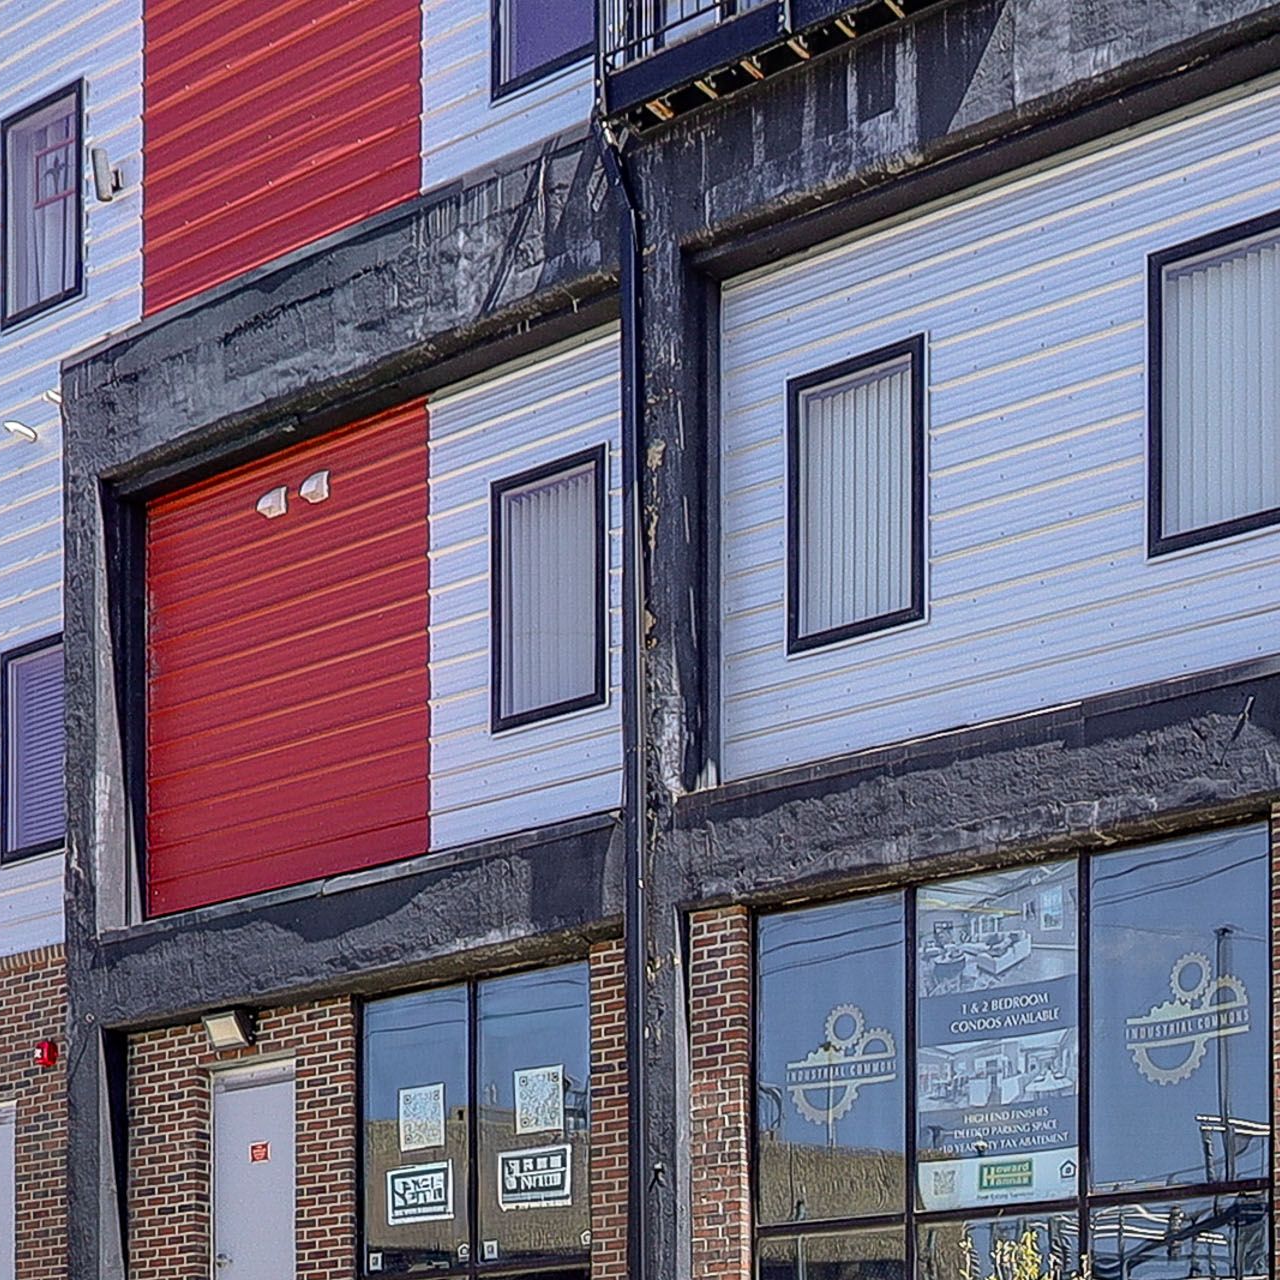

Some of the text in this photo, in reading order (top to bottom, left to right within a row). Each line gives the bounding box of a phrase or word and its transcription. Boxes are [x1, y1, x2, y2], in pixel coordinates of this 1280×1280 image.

[961, 993, 1050, 1015] 1 & 2 BEDROOM
[950, 1008, 1060, 1034] CONDOS AVAILABLE
[1125, 1009, 1250, 1040] INDUSTRIAL COMMONS
[786, 1060, 898, 1082] INDUSTRIAL COMMONS
[991, 1122, 1031, 1136] PARKING
[1032, 1118, 1058, 1130] SPACE
